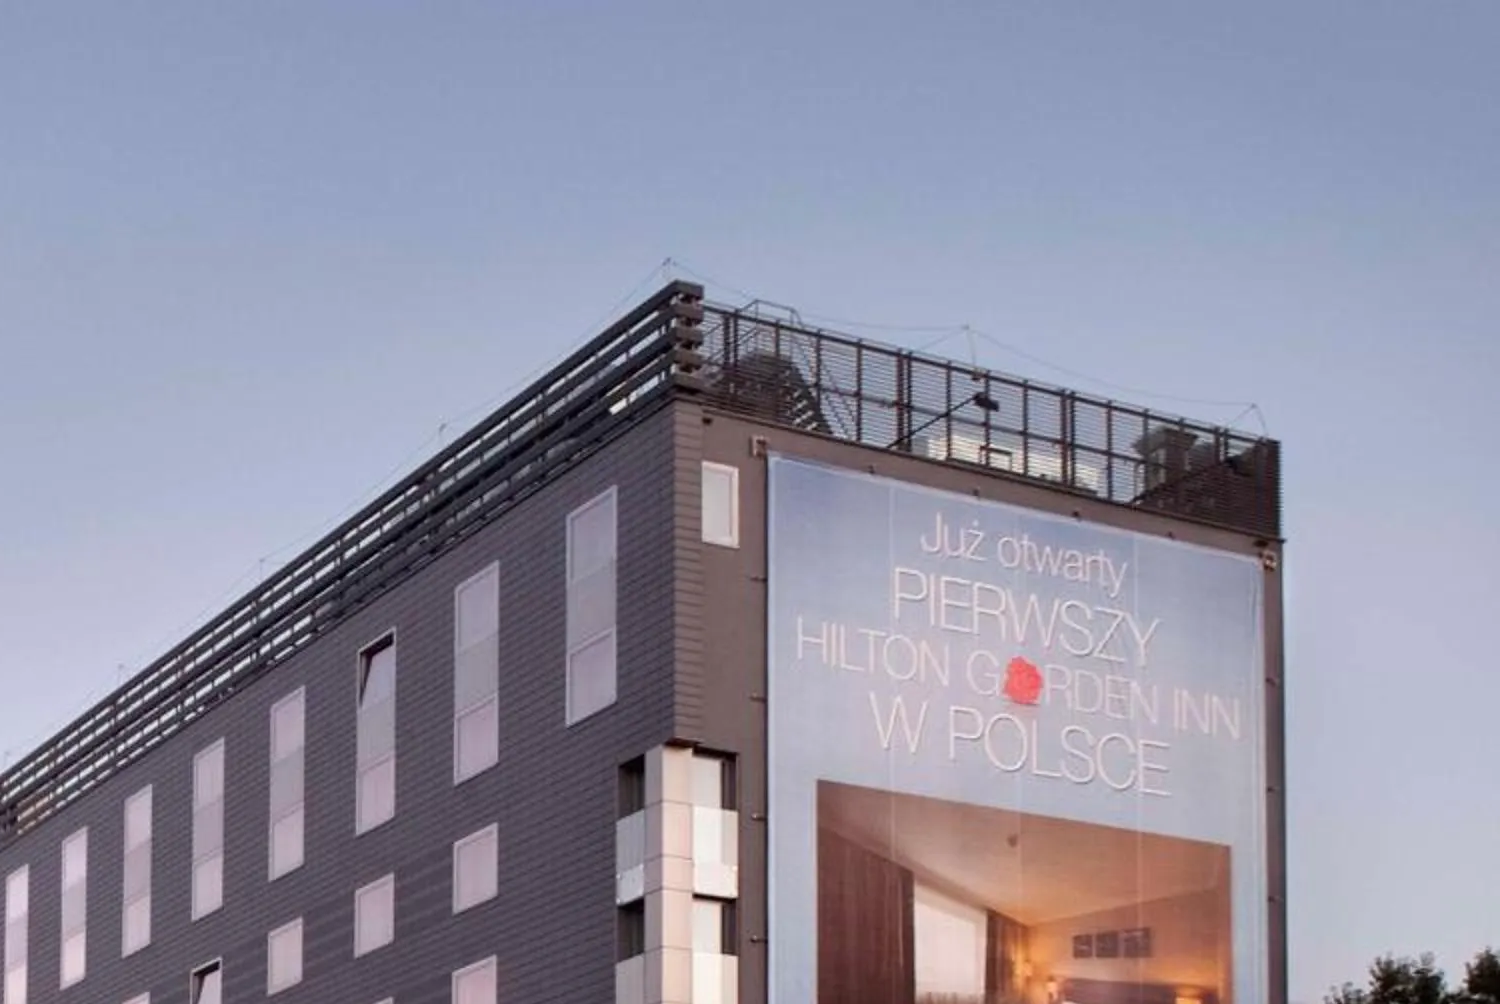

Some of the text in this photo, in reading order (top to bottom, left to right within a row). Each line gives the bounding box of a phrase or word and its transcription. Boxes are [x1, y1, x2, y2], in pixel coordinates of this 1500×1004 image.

[921, 512, 1128, 598] Już otwarty
[893, 567, 1161, 667] PIERWSZY
[796, 616, 1241, 741] HILTON GRDEN INN
[869, 691, 1172, 796] W POLSCE
